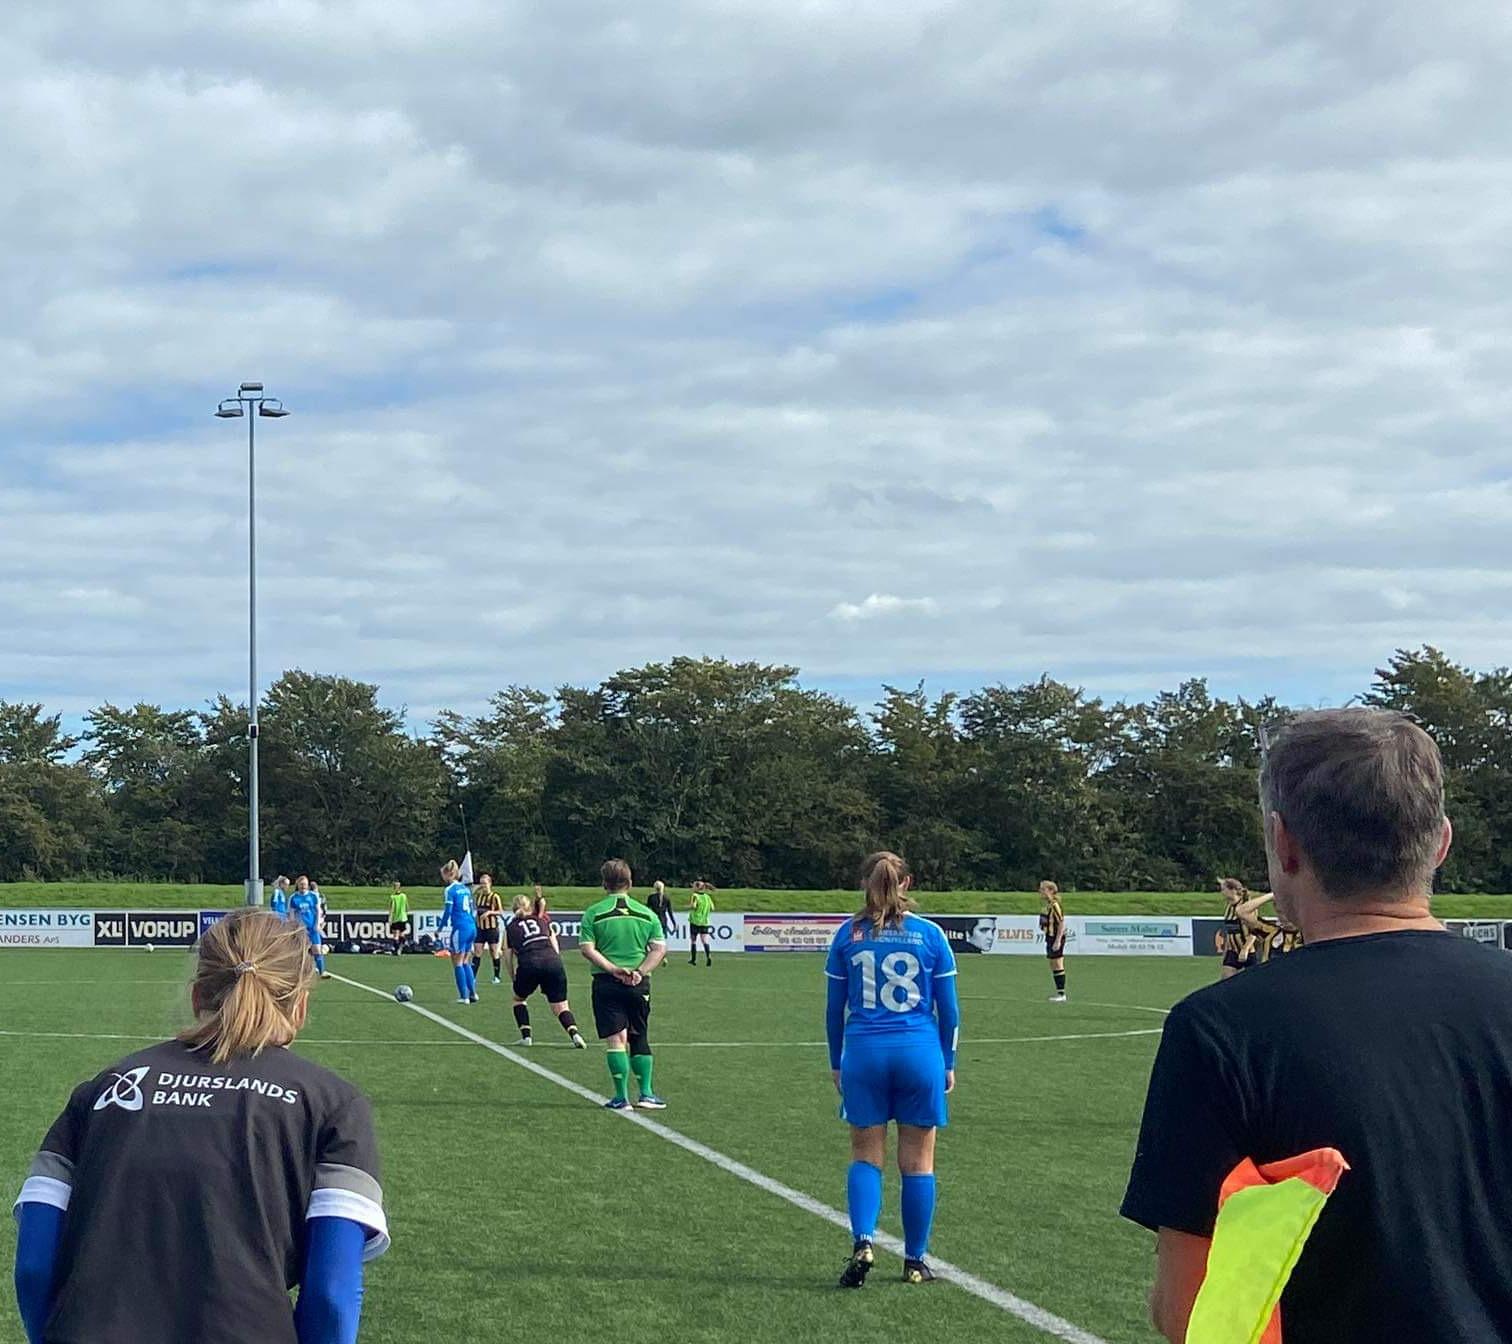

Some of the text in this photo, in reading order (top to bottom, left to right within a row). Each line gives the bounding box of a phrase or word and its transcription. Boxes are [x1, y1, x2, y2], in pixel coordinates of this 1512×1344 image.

[58, 914, 91, 926] BYG
[518, 919, 541, 937] 13
[131, 921, 195, 937] VORUP
[664, 925, 733, 940] MIRO
[998, 929, 1033, 940] ELVIS
[851, 950, 922, 1013] 18
[157, 1072, 298, 1105] DJURSLANDS
[152, 1091, 213, 1107] BANK
